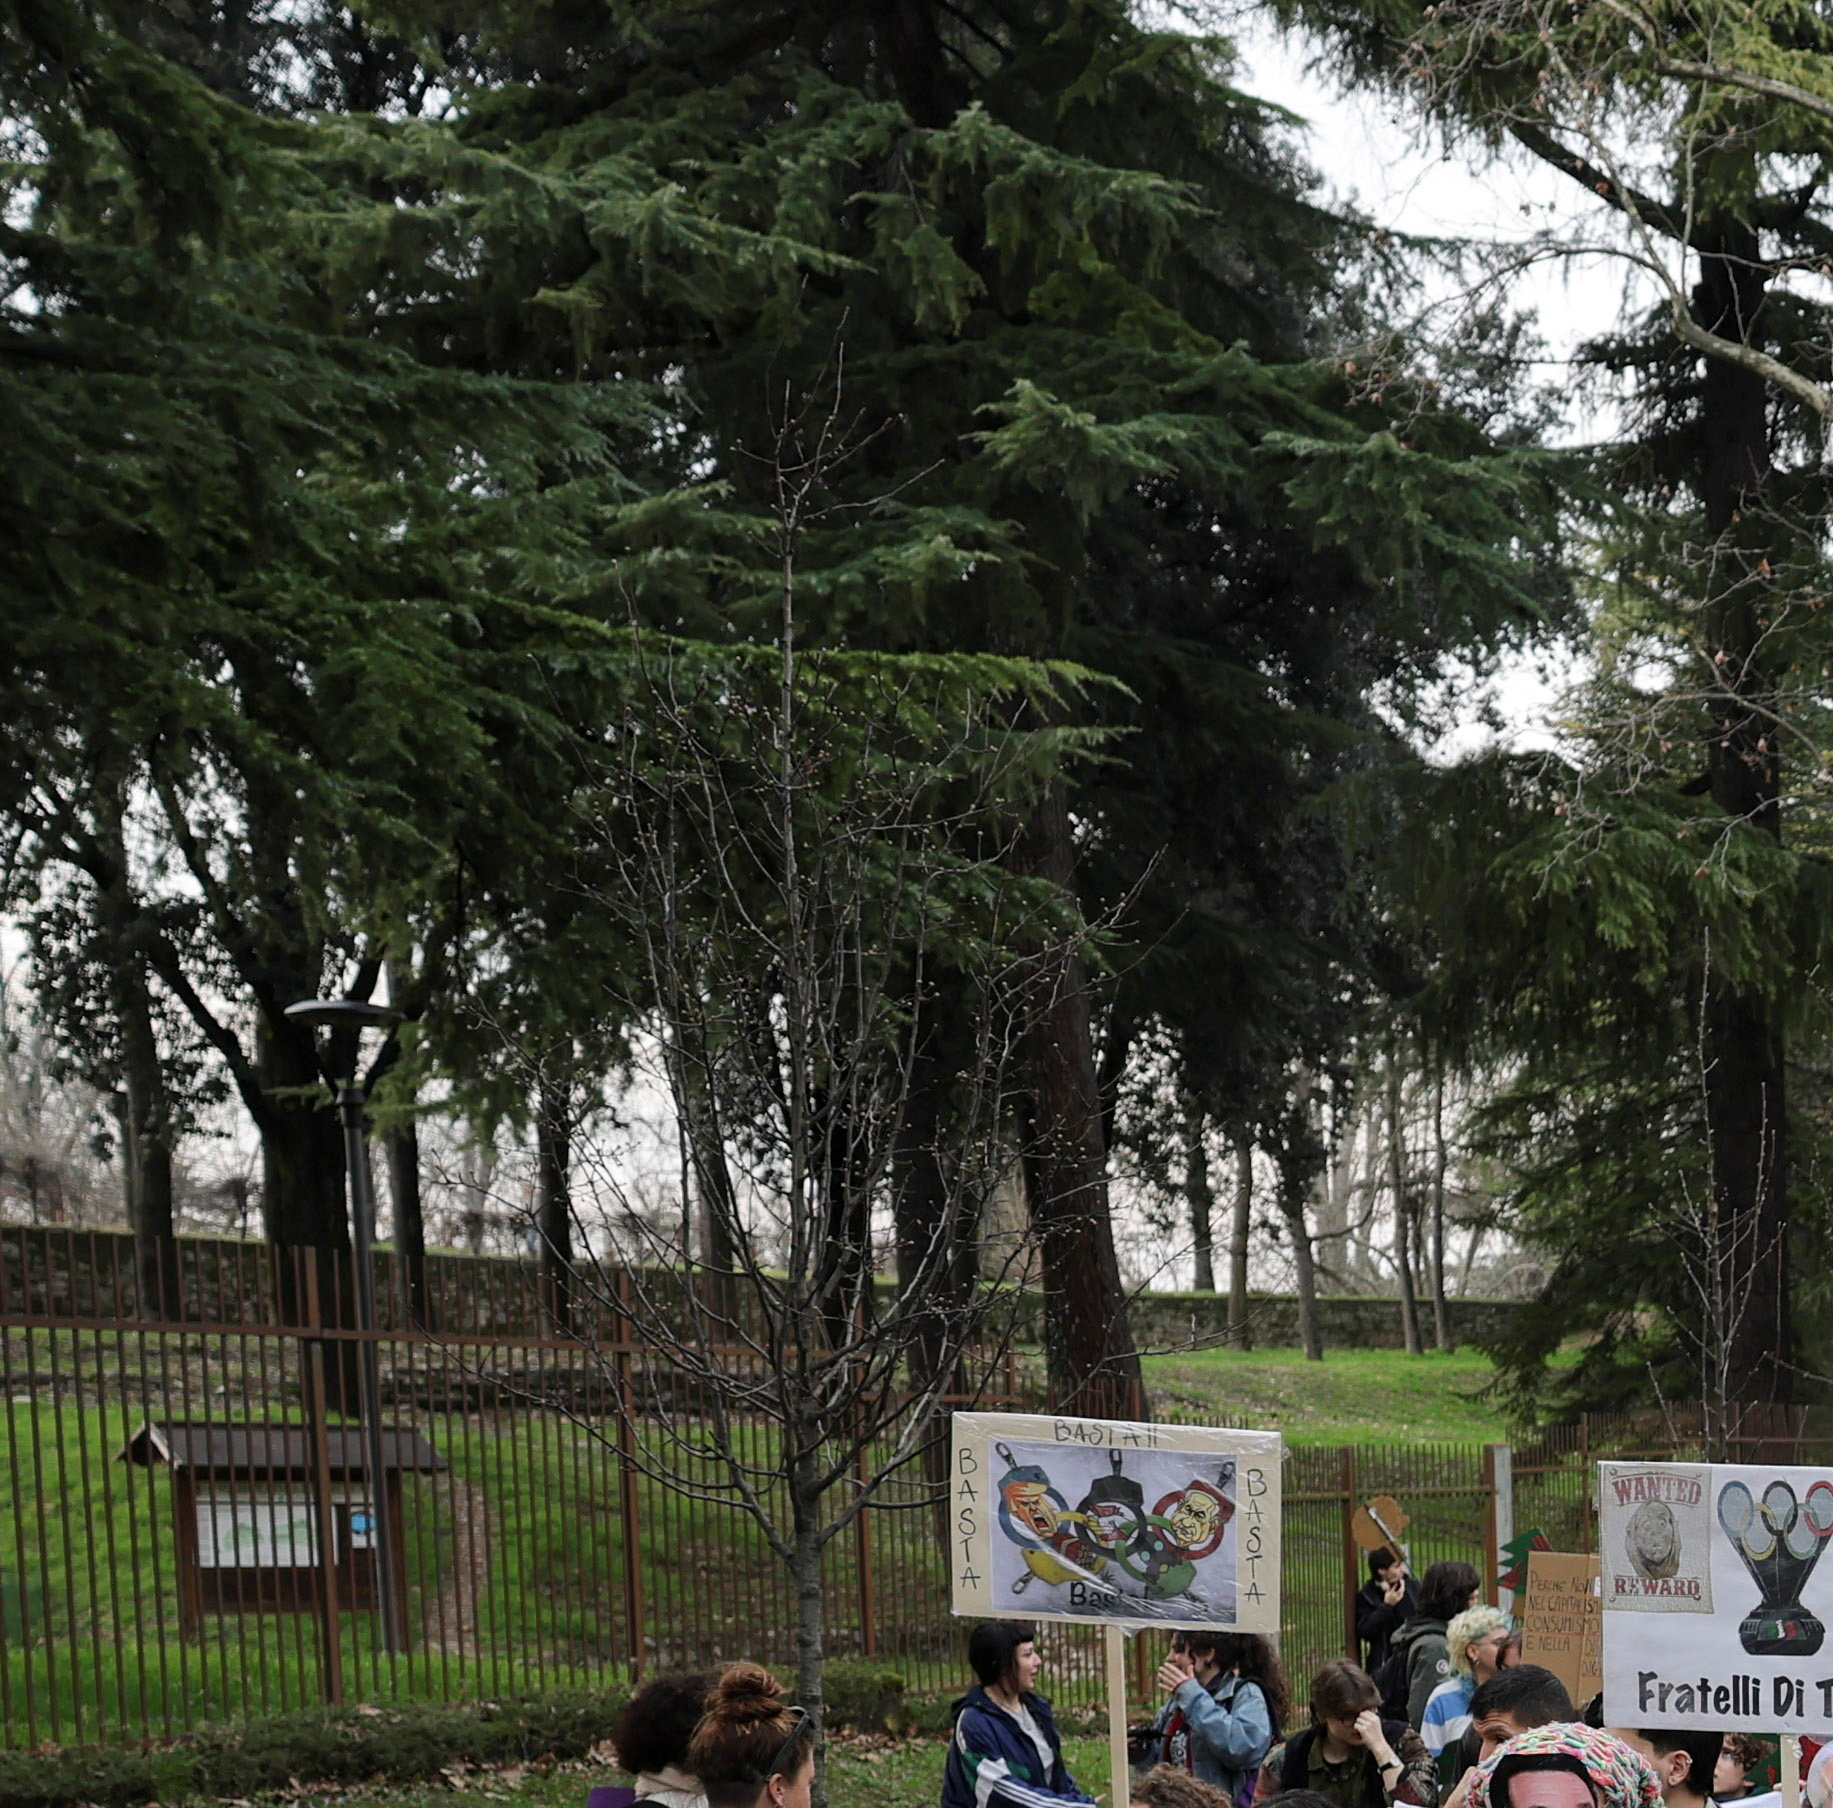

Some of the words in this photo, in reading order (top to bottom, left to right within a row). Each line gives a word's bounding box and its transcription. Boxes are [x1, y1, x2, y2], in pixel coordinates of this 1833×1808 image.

[1612, 1473, 1702, 1505] WANTED
[1613, 1575, 1701, 1597] REWARD
[1547, 1595, 1600, 1615] CAPITALISM
[1637, 1671, 1761, 1717] Fratelli
[1773, 1675, 1805, 1719] Di
